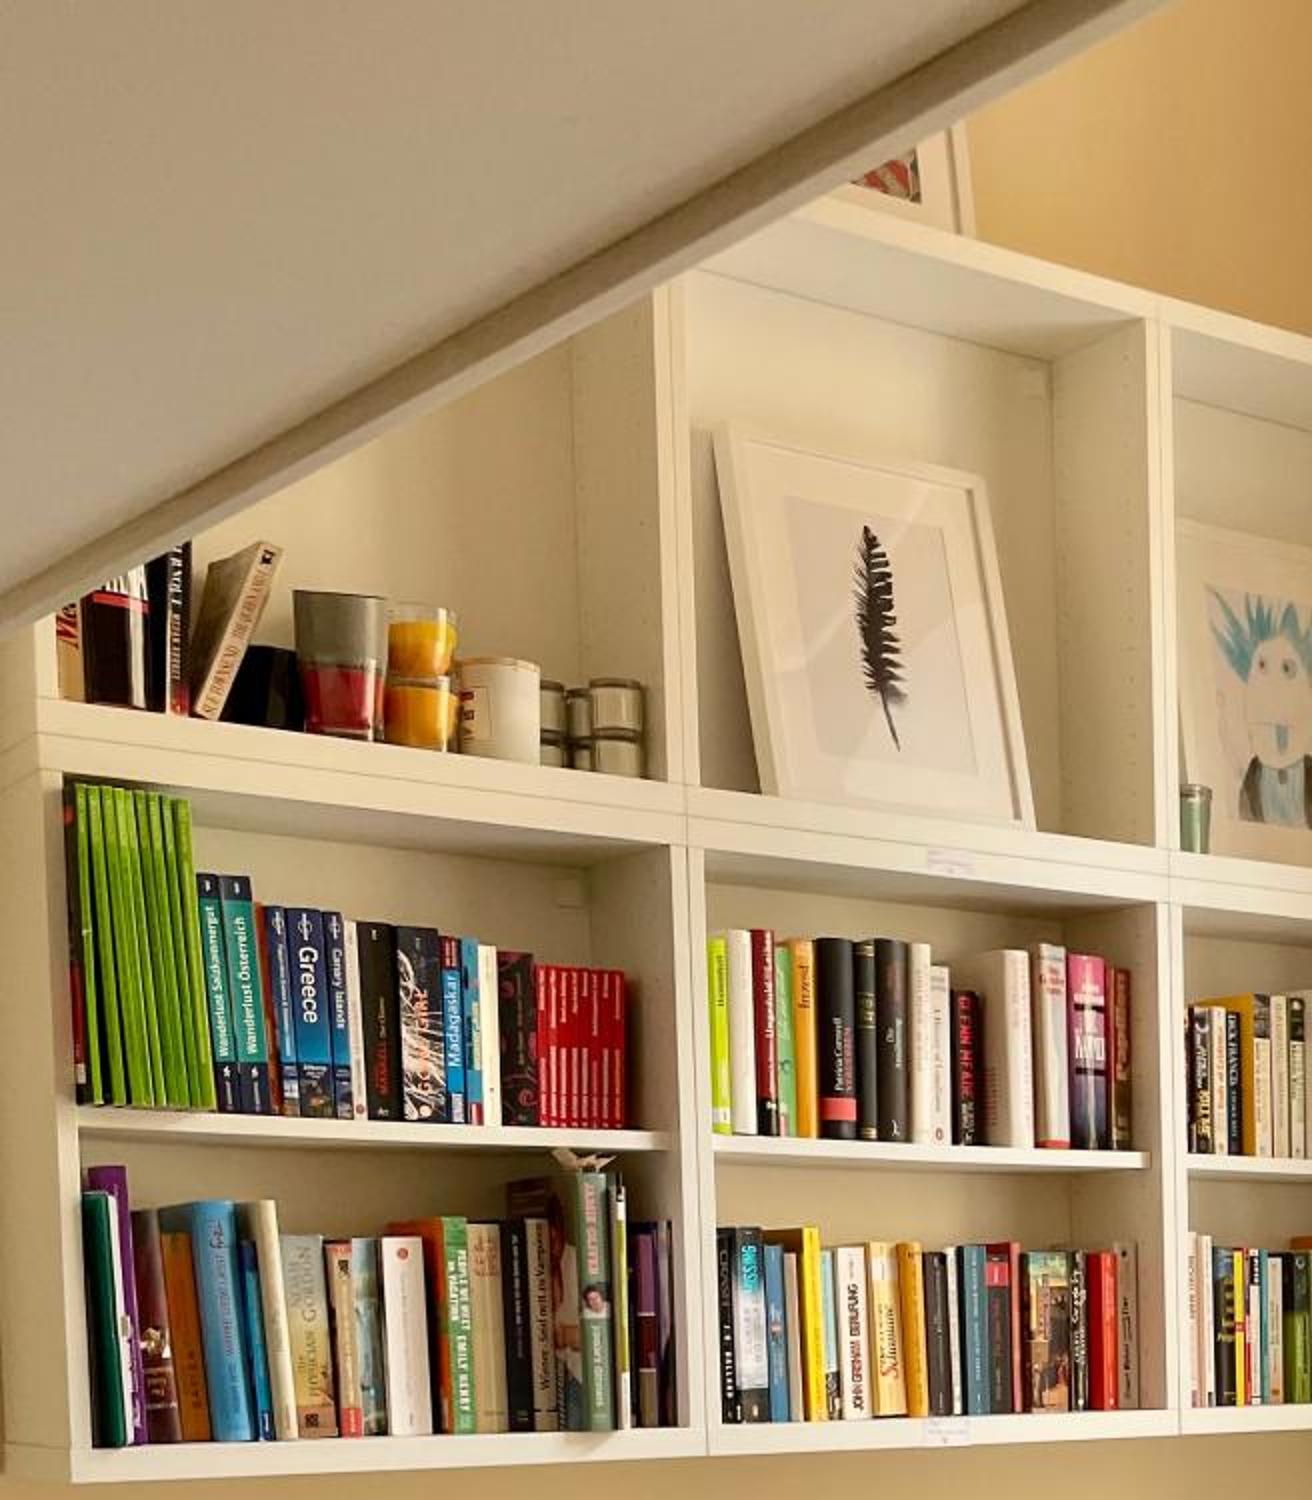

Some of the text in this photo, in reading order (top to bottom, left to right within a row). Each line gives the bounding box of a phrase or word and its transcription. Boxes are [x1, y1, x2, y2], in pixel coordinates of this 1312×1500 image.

[234, 916, 257, 1056] Wanderlust Österreich
[299, 947, 319, 1024] Greece
[332, 948, 343, 987] Canary
[213, 994, 229, 1057] Wanderlust
[335, 991, 345, 1029] Islands
[446, 975, 462, 1067] Madagaskar
[724, 1352, 734, 1399] BALLARD
[848, 1284, 864, 1412] JOHN GRISHAM BERUFUNG
